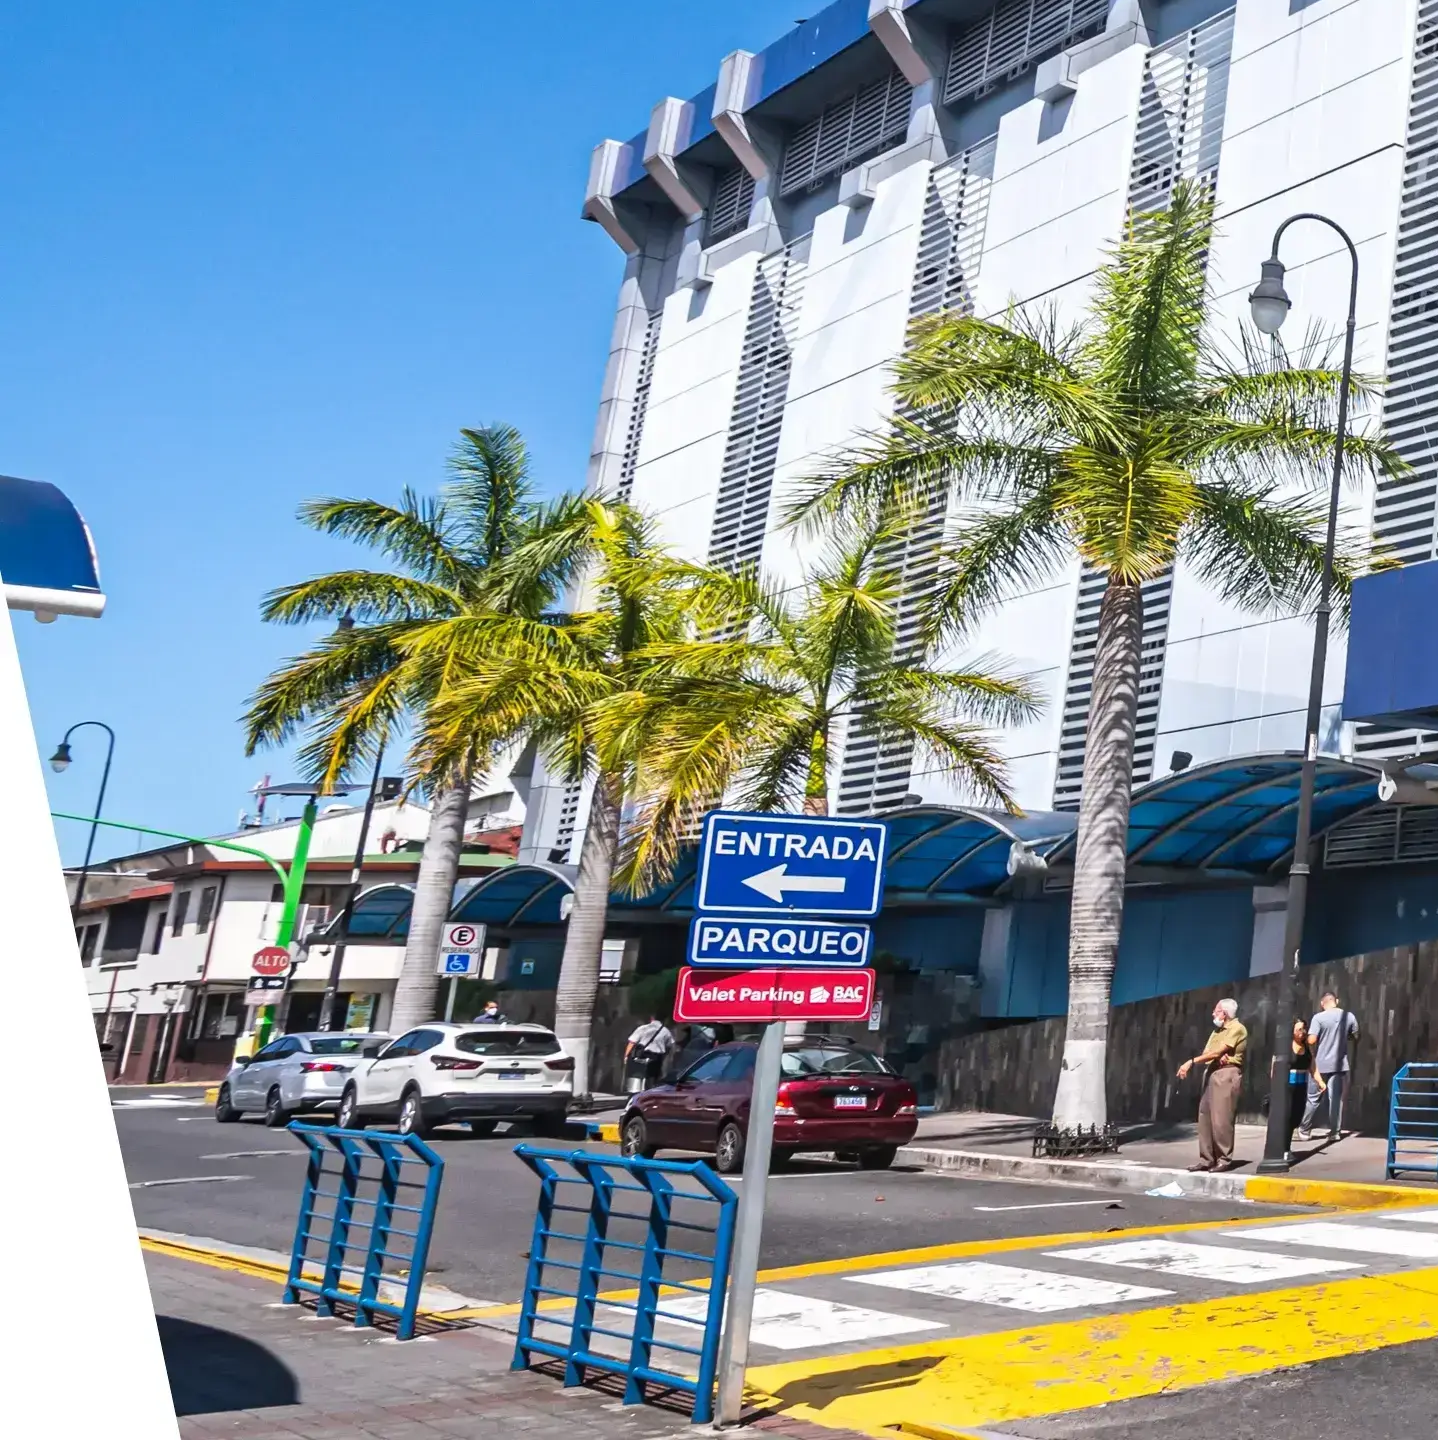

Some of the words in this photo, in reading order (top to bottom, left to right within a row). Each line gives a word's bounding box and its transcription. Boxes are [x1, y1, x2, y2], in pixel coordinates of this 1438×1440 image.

[715, 830, 876, 861] ENTRADA
[457, 930, 469, 941] E
[701, 927, 863, 956] PARQUEO
[254, 955, 289, 966] ALTO
[689, 987, 736, 1001] Valet
[740, 987, 805, 1004] Parking
[833, 986, 865, 999] BAC
